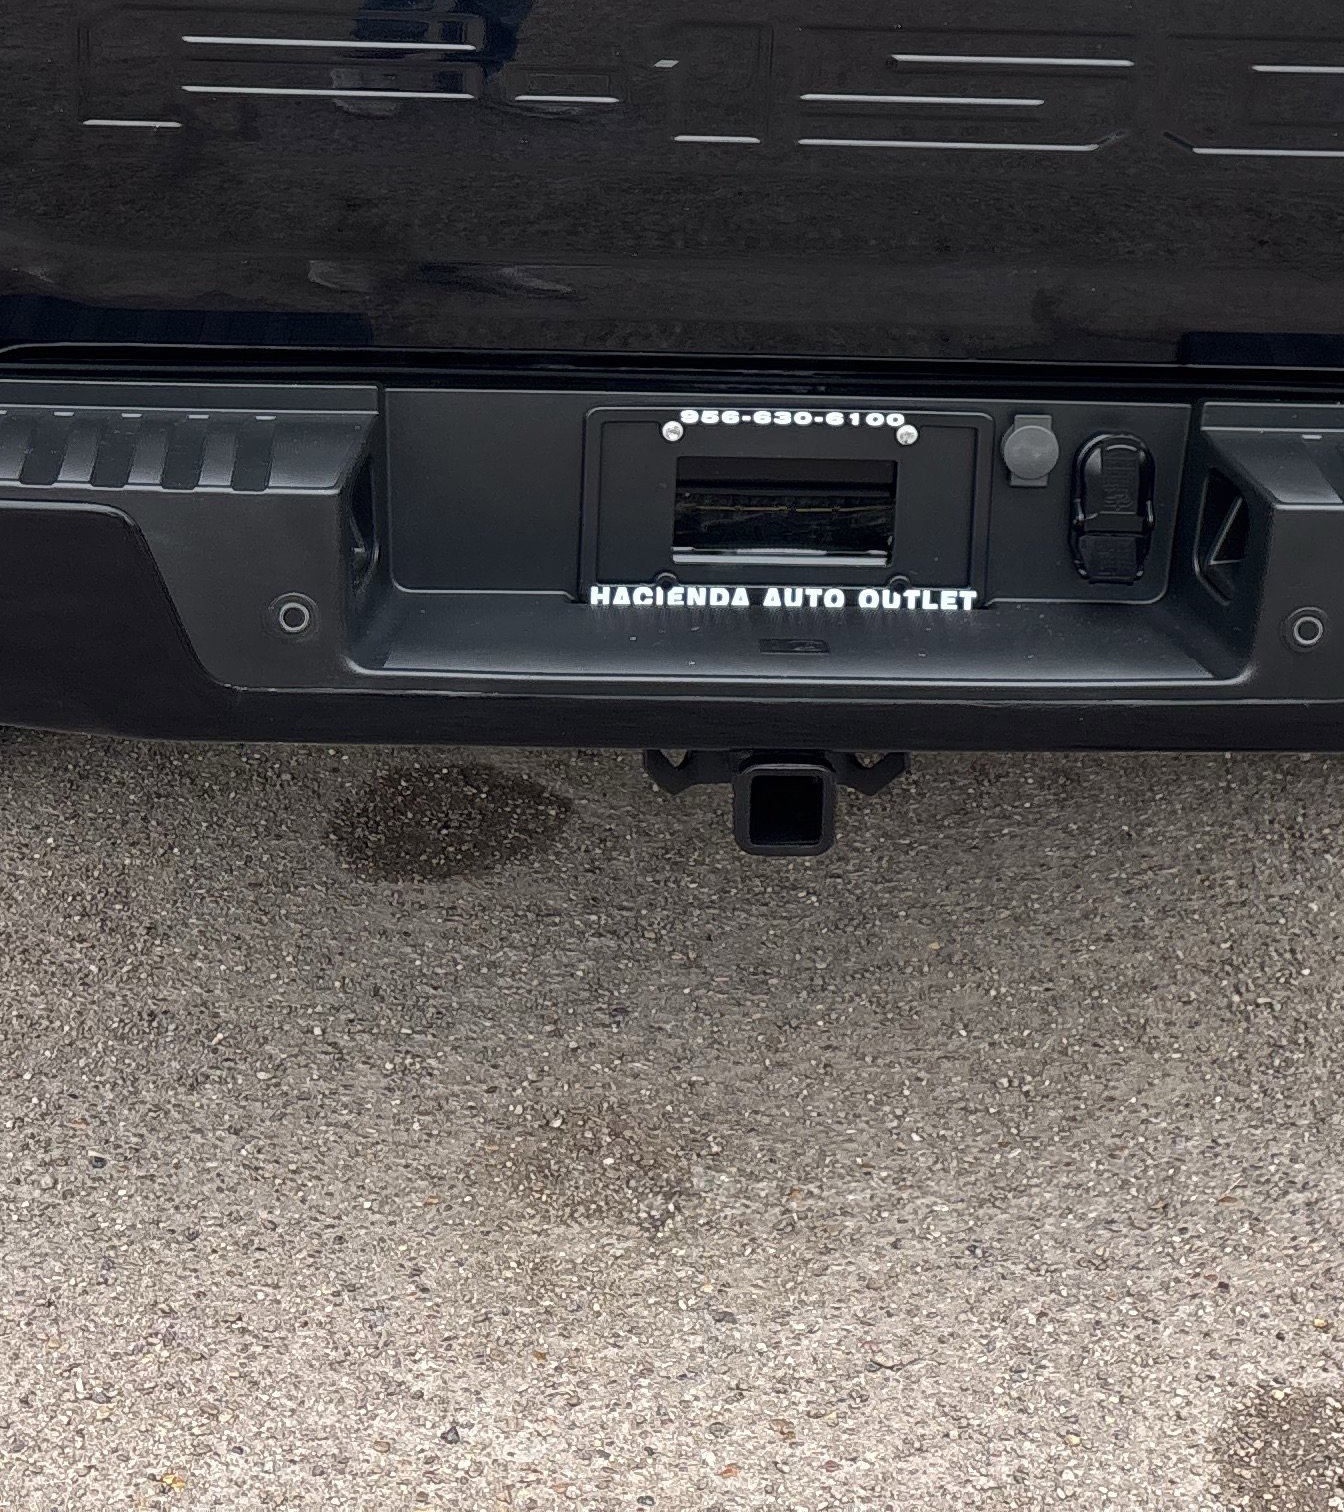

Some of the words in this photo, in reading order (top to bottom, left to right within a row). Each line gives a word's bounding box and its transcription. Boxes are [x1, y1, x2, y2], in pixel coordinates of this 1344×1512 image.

[680, 409, 907, 428] 956-630-6100
[590, 586, 751, 607] HACIENDA
[763, 587, 846, 609] AUTO
[858, 589, 979, 612] OUTLET
